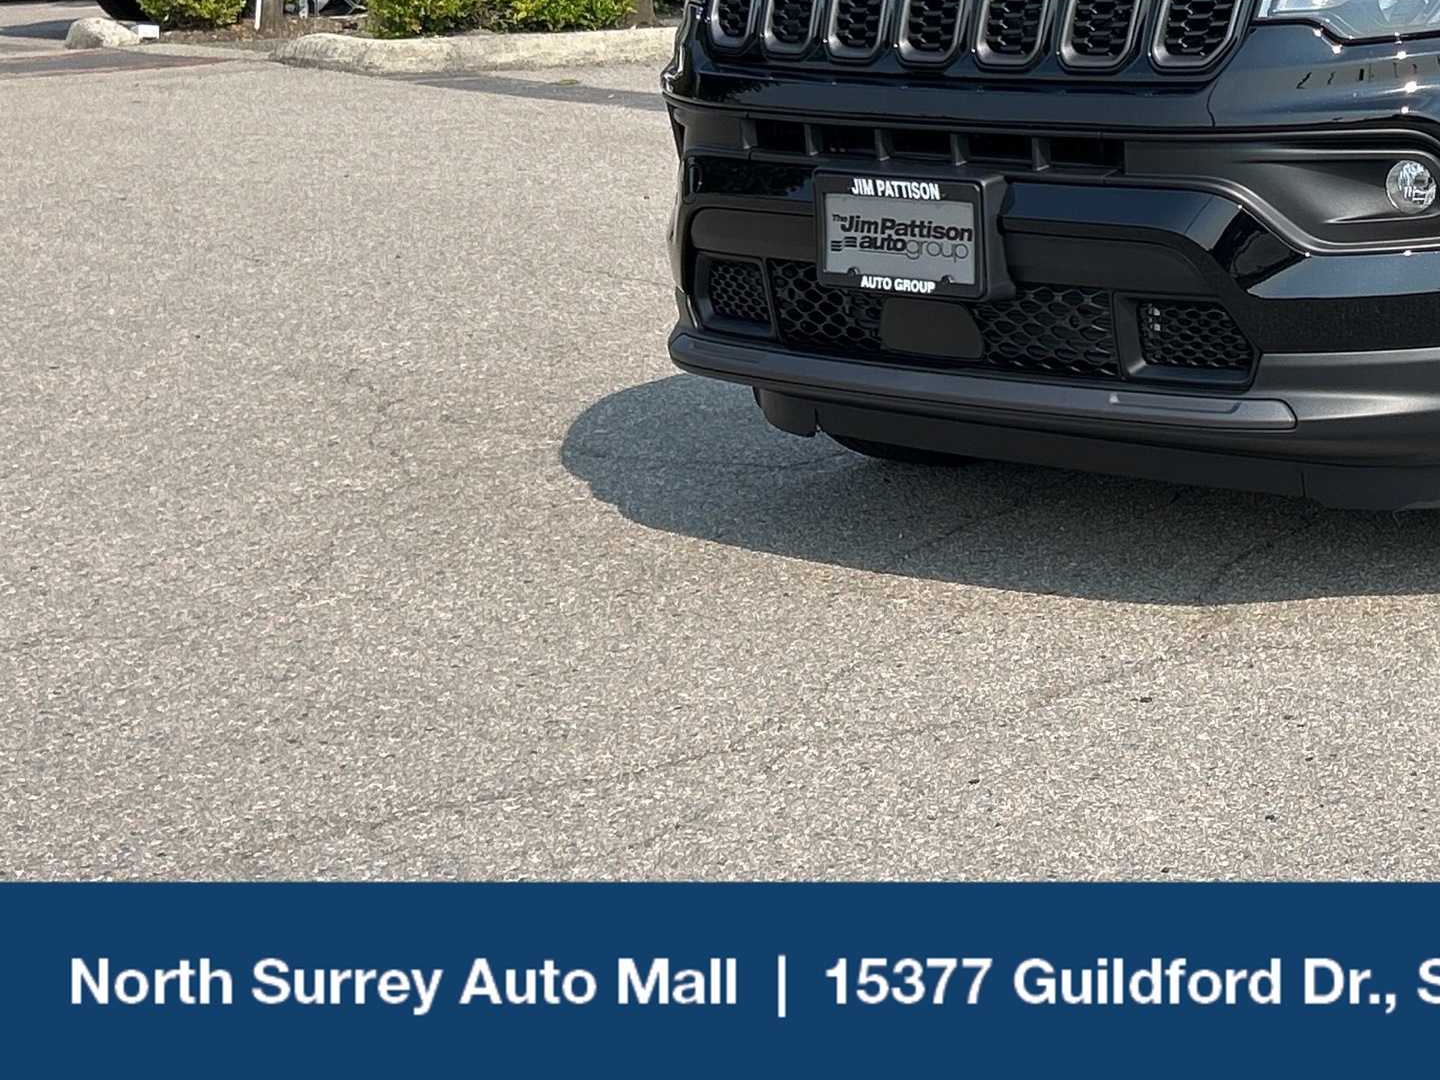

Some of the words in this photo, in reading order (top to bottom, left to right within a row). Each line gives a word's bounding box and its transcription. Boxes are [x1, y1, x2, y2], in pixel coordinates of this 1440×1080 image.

[851, 177, 874, 196] JIM
[876, 178, 941, 201] PATTISON
[860, 275, 893, 290] AUTO
[894, 278, 936, 294] GROUP
